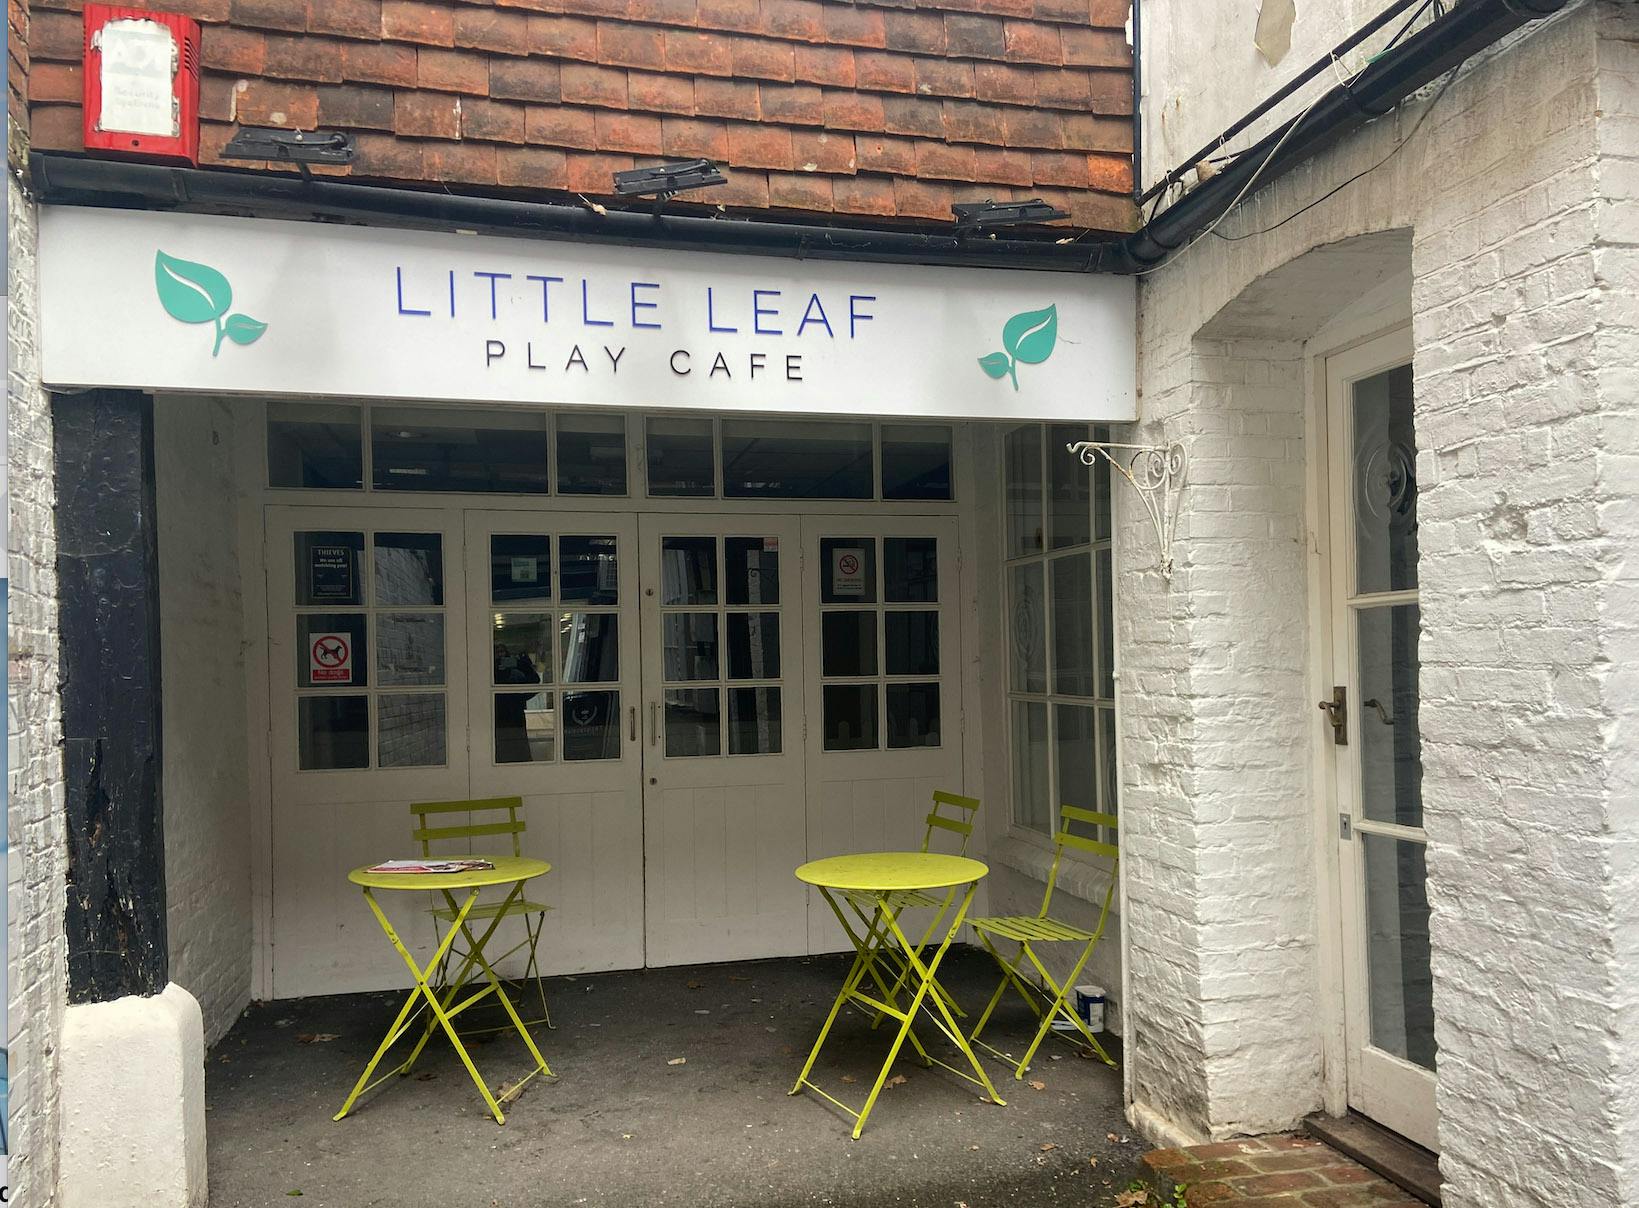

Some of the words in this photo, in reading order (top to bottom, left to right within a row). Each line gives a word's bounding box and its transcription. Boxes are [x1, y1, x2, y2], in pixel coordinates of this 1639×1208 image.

[396, 266, 662, 329] LITTLE
[707, 287, 876, 339] LEAF
[486, 340, 626, 373] PLAY
[669, 349, 803, 382] CAFE
